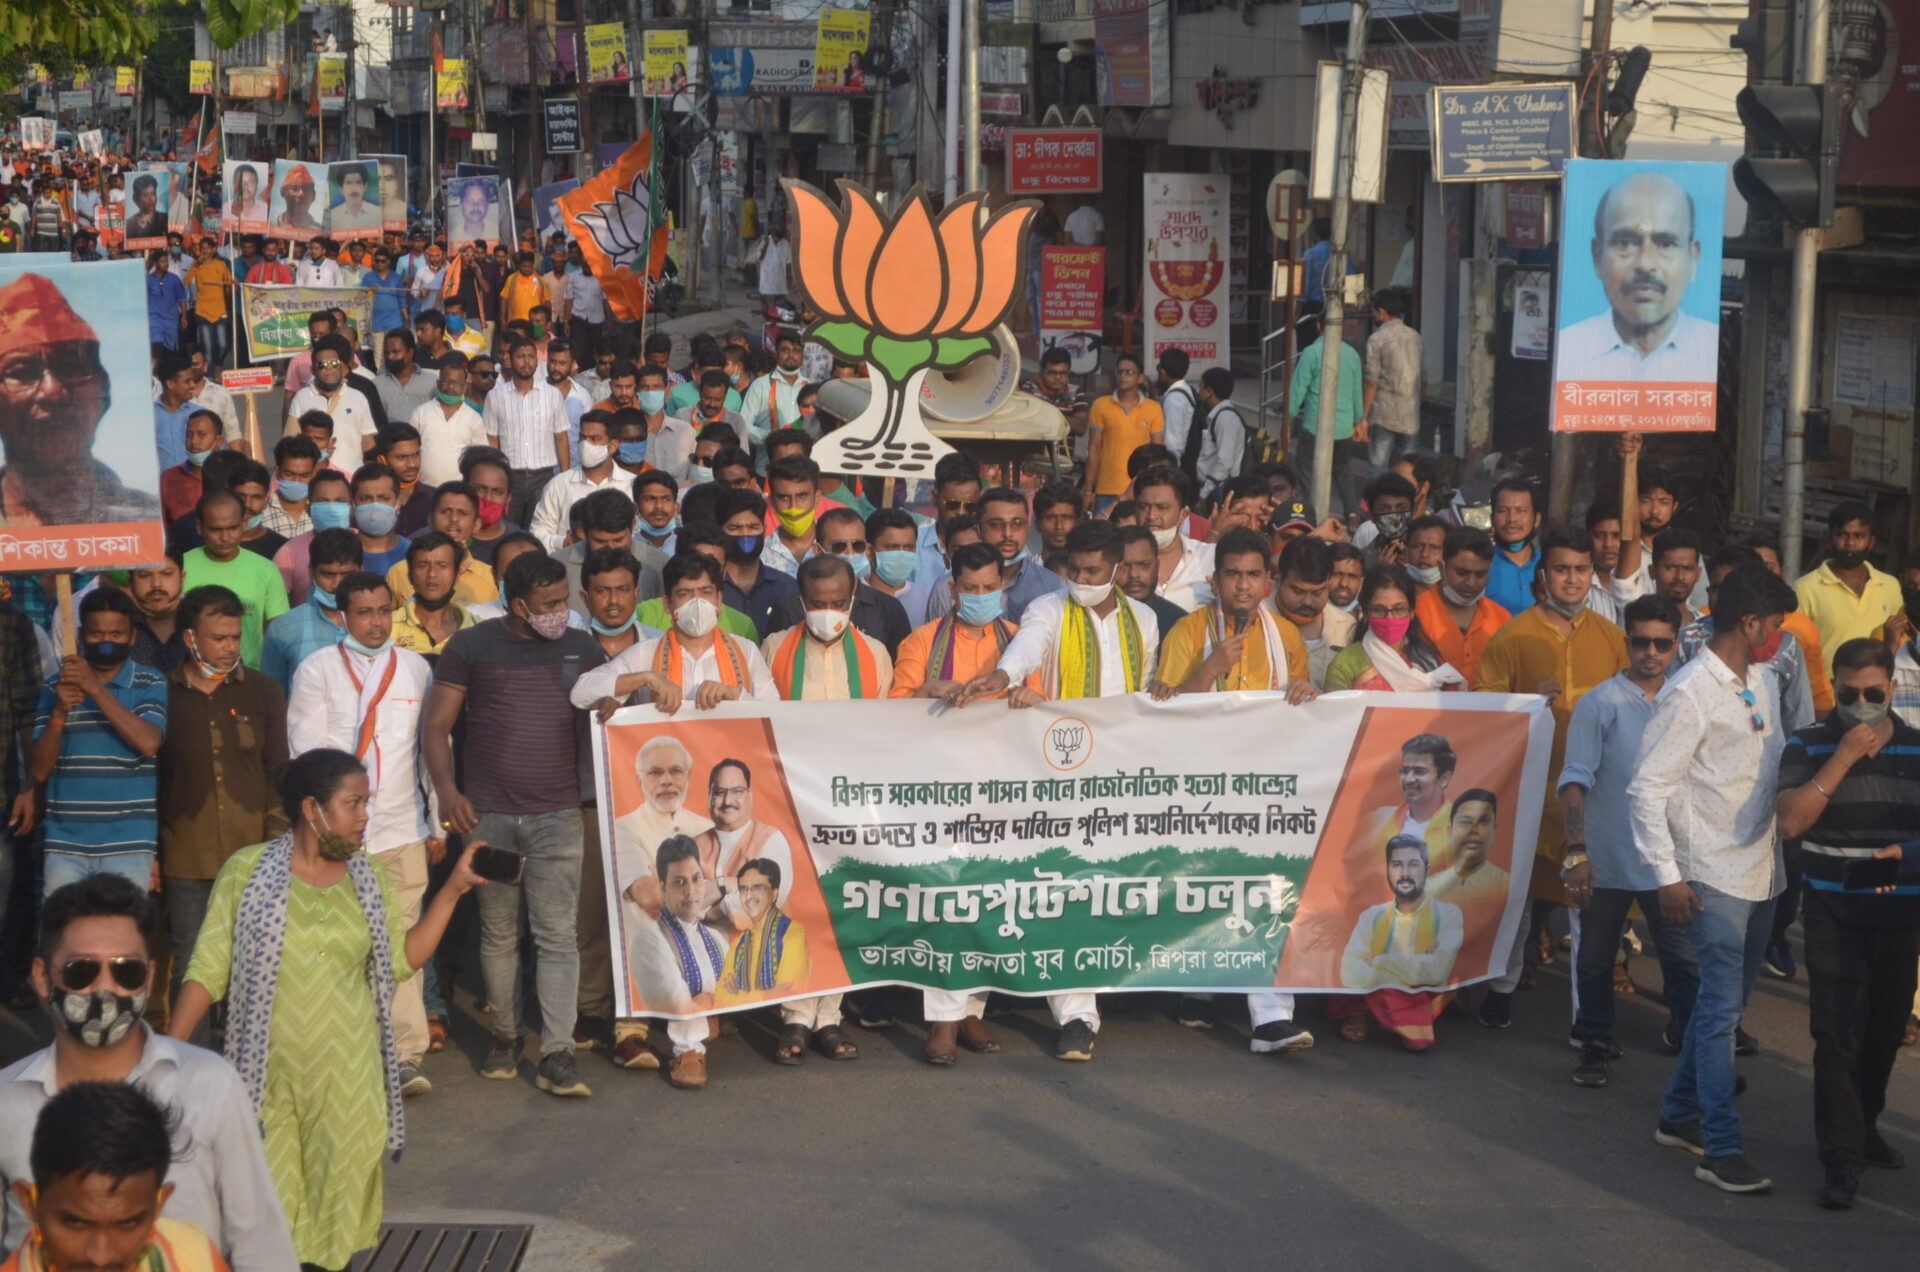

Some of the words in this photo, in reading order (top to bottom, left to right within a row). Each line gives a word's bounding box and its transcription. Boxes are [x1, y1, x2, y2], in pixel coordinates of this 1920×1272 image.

[1562, 382, 1639, 407] বীরলাল
[1644, 388, 1713, 407] সরকার
[0, 534, 69, 562] শিকান্ত
[74, 533, 140, 558] চাকমা
[831, 776, 884, 807] বিগত
[888, 780, 972, 807] সরকারের
[978, 779, 1028, 805] শাসন
[1032, 778, 1076, 802] কালে
[1080, 767, 1179, 801] রাজনৈতিক
[1184, 772, 1227, 797] হত্যা
[811, 824, 857, 846] দ্রুত
[862, 823, 917, 848] তদন্ত
[921, 821, 937, 845] ও
[943, 813, 1008, 845] শাস্তির
[1012, 810, 1073, 841] দাবিতে
[1078, 807, 1129, 847] পুলিশ
[1134, 801, 1260, 837] মহানির্দেশকের
[1265, 804, 1317, 836] নিকট
[842, 867, 1162, 941] গণডেপুটেশনে
[1174, 873, 1286, 934] চলুন
[858, 939, 953, 975] ভারতীয়
[960, 949, 1027, 976] জনতা
[1032, 948, 1065, 980] যুব
[1074, 936, 1141, 972] মোর্চা,
[1149, 943, 1207, 974] ত্রিপুরা
[1213, 949, 1267, 970] প্রদেশ
